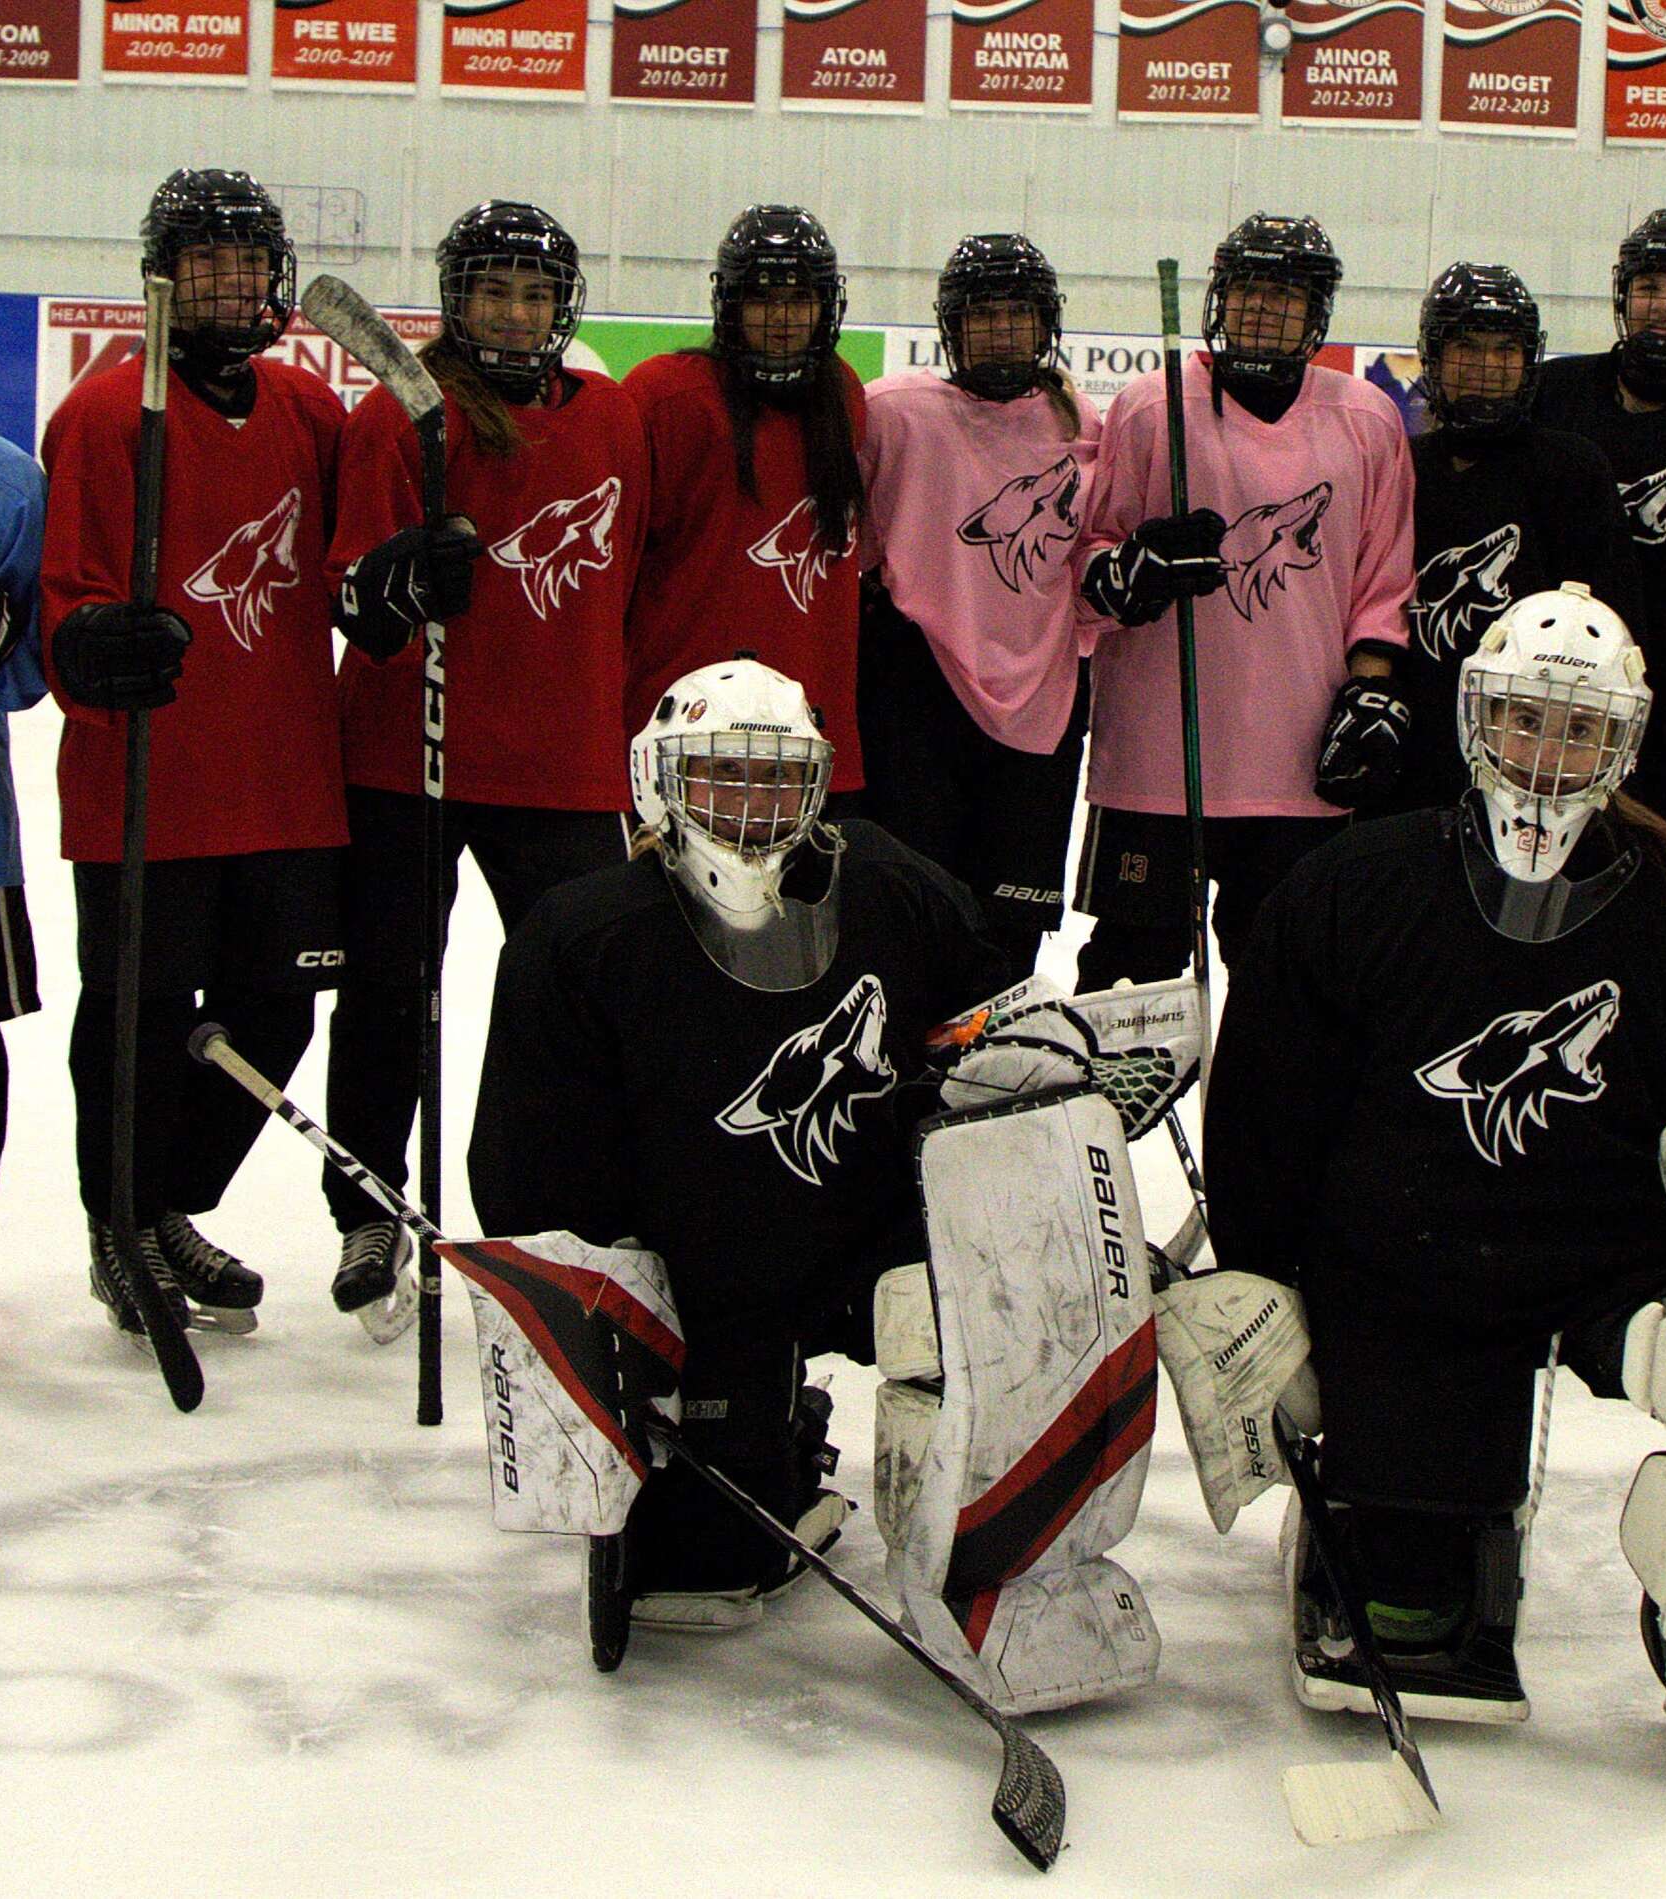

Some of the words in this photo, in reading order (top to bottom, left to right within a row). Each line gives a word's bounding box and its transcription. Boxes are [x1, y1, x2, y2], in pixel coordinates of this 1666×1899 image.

[111, 12, 179, 34] MINOR
[184, 14, 242, 36] ATOM
[293, 18, 339, 41] PEE
[345, 20, 397, 43] WEE
[125, 39, 227, 59] 2010-2011
[451, 27, 510, 48] MINOR
[511, 29, 575, 51] MIDGET
[983, 31, 1063, 52] MINOR
[294, 46, 395, 67] 2010-2011
[464, 54, 563, 74] 2010-2011
[638, 44, 730, 66] MIDGET
[820, 46, 888, 68] ATOM
[974, 50, 1069, 71] BANTAM
[1314, 48, 1392, 68] MINOR
[639, 68, 728, 89] 2010-2011
[810, 70, 897, 89] 2011-2012
[1145, 60, 1233, 81] MIDGET
[1305, 66, 1399, 87] BANTAM
[979, 73, 1065, 92] 2011-2012
[1146, 83, 1232, 101] 2011-2012
[1468, 73, 1553, 94] MIDGET
[1310, 89, 1394, 108] 2012-2013
[1468, 95, 1552, 115] 2012-2013
[51, 305, 100, 323] HEAT
[1089, 350, 1164, 375] POO
[1231, 358, 1273, 372] CCM
[753, 367, 804, 382] CCM
[1532, 652, 1599, 672] BAUER
[423, 620, 447, 800] CCM
[728, 721, 793, 736] WARRIOR
[1118, 849, 1151, 883] 13
[1085, 1143, 1131, 1301] BAUER
[1212, 1296, 1282, 1373] WARRIOR
[490, 1340, 521, 1496] BAUER
